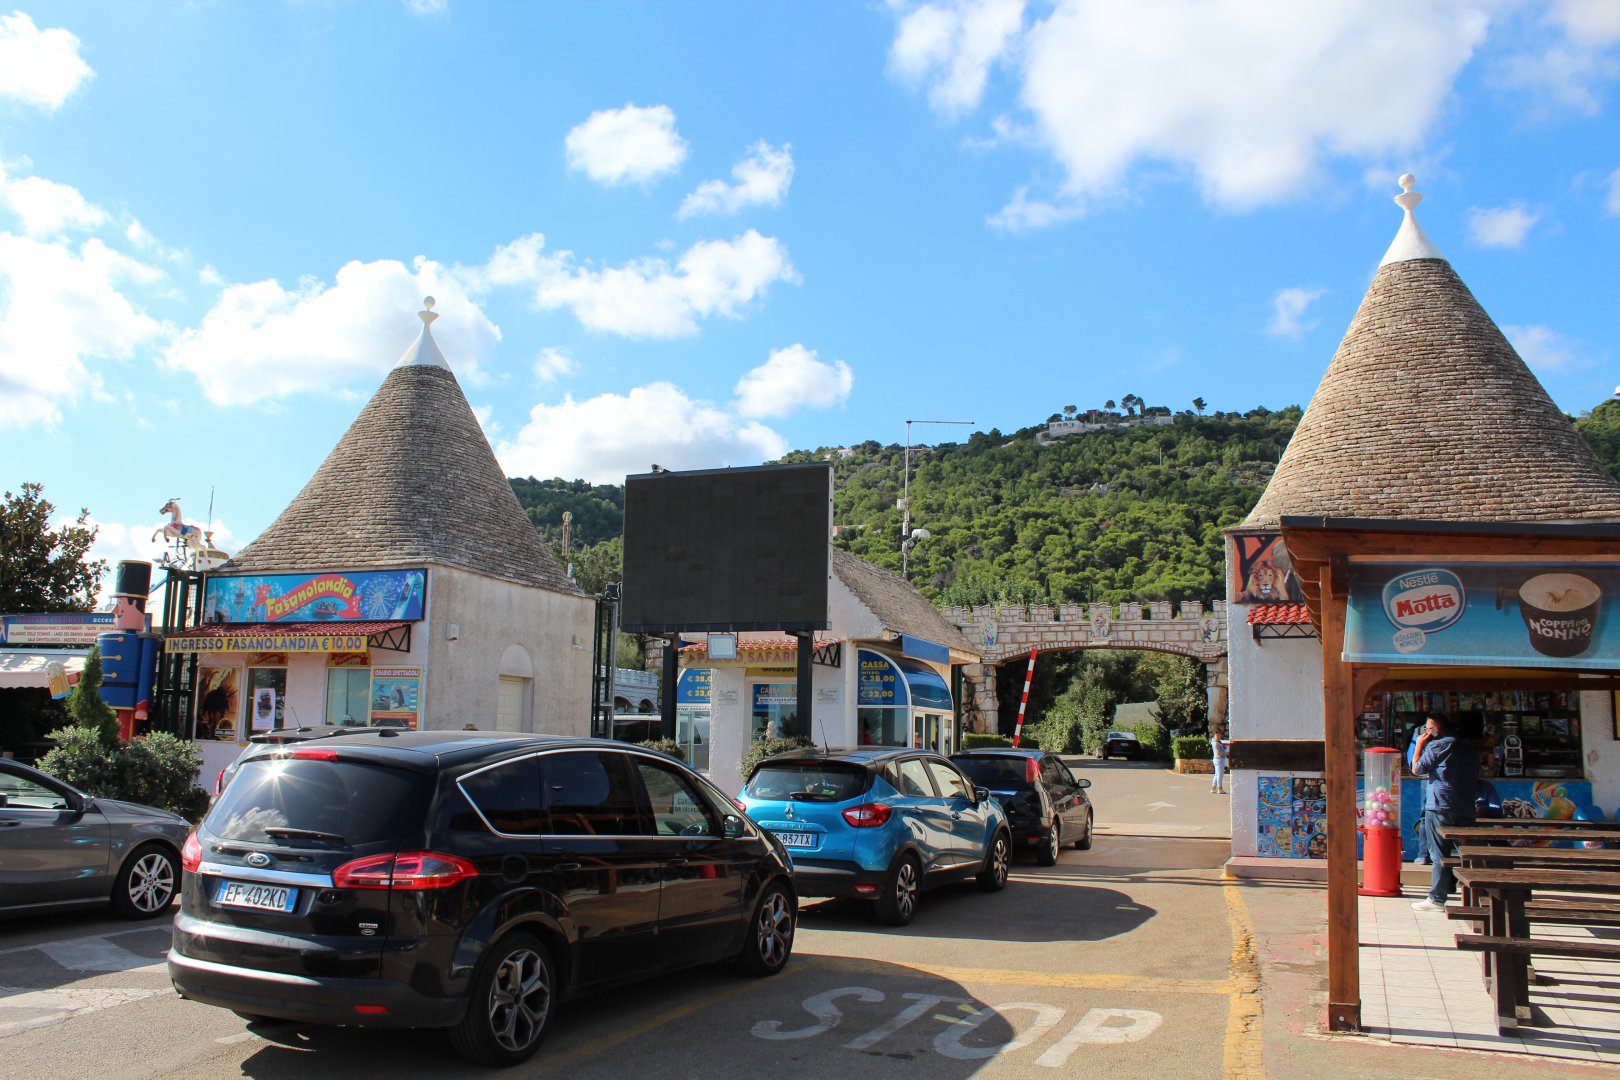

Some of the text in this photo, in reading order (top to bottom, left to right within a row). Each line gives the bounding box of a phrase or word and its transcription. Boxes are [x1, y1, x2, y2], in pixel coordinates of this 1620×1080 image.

[1399, 572, 1440, 590] Nestlé
[266, 576, 353, 617] Fasanolandia
[1396, 593, 1457, 618] Motta
[1529, 618, 1592, 641] NONNO
[1540, 618, 1575, 628] COPPA
[168, 637, 362, 651] INGRESSO FASANOLANDIA € 10,00
[748, 651, 796, 664] SAFARI
[861, 660, 890, 669] CASSA
[868, 690, 894, 698] 22.00
[782, 833, 811, 845] 837TX
[225, 883, 288, 909] EF 402KD
[750, 985, 1164, 1068] STOP
